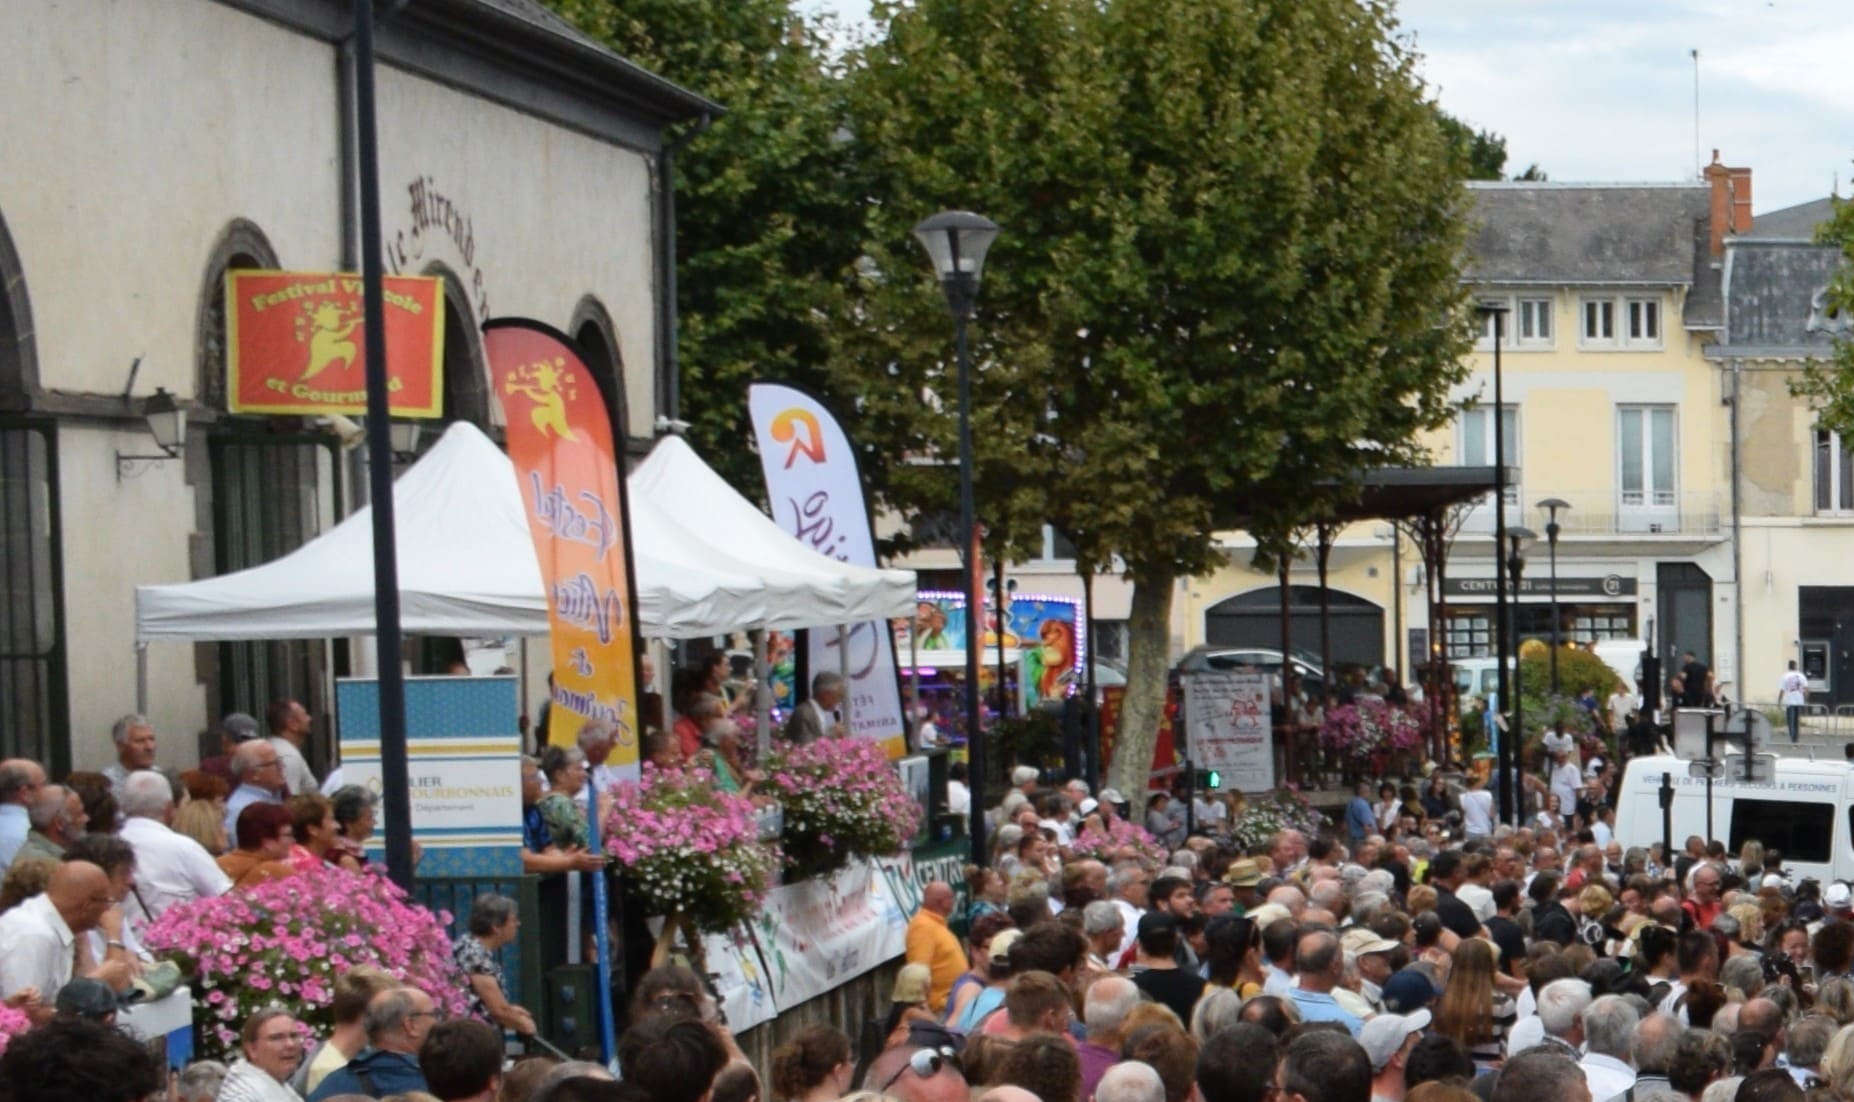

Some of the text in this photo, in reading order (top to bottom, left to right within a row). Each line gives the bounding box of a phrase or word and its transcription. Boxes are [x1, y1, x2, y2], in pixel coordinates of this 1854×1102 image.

[252, 278, 423, 315] Festival Vicole
[266, 377, 289, 392] et
